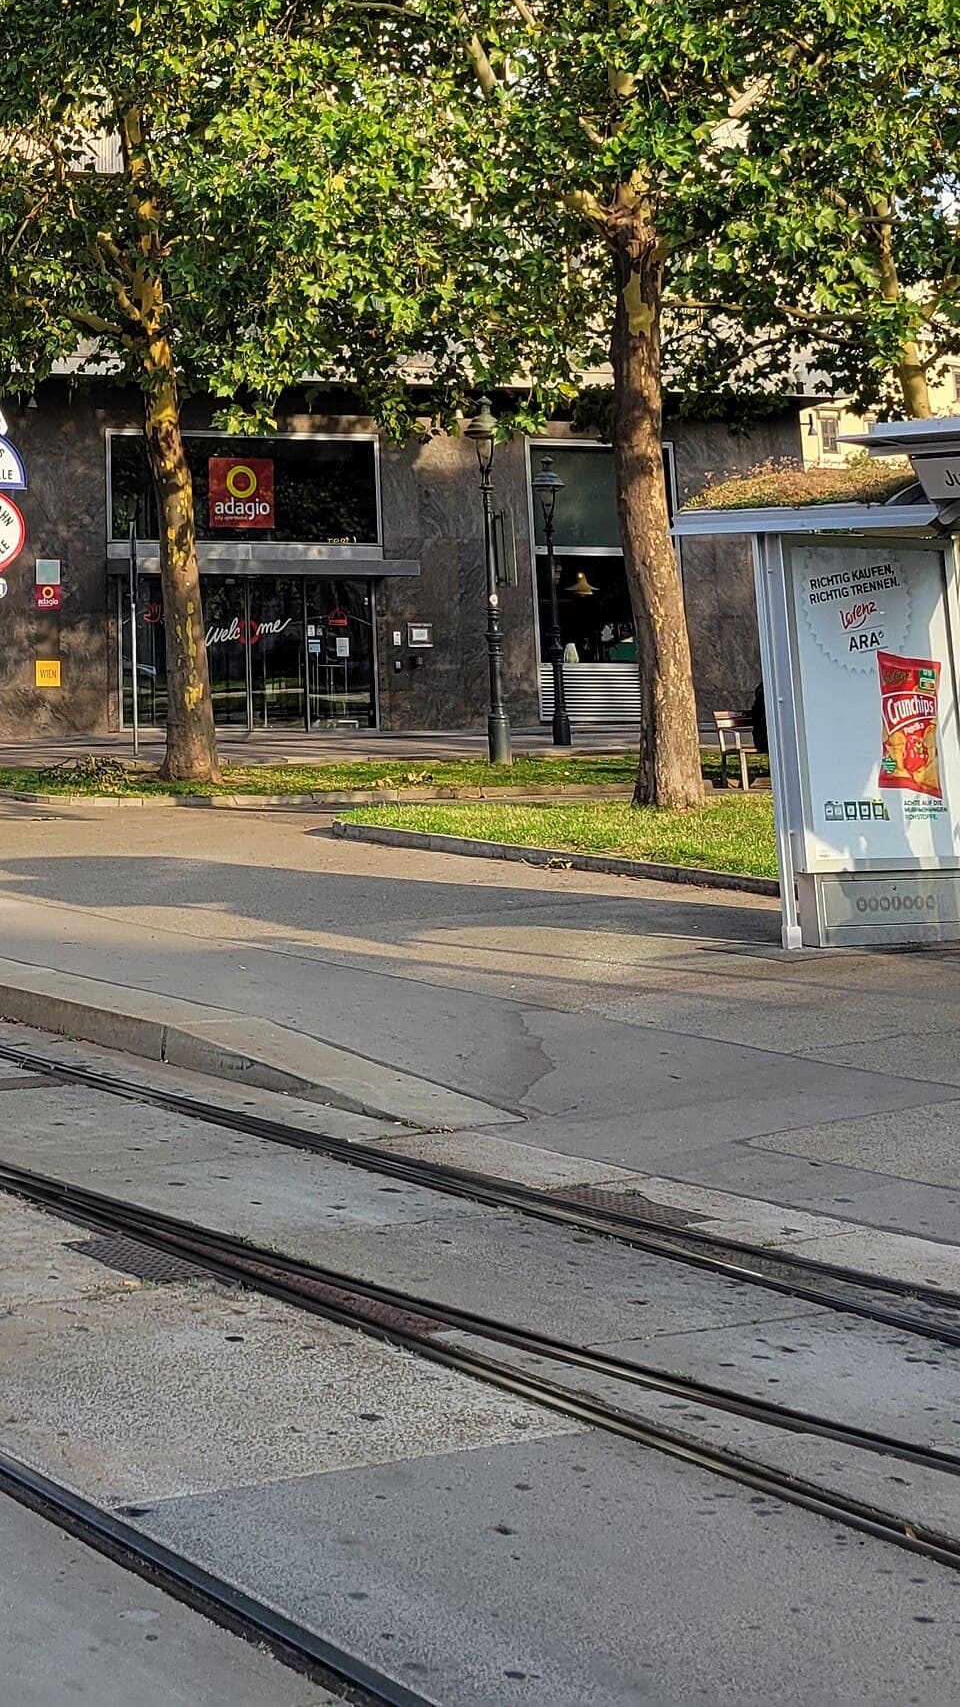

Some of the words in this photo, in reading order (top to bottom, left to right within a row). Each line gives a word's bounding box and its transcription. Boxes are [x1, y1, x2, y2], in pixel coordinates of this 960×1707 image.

[214, 497, 270, 520] adagio
[809, 572, 850, 590] RICHTIG
[851, 563, 895, 582] KAUFEN,
[37, 597, 59, 607] adagio
[809, 586, 849, 605] RICHTIG
[850, 576, 901, 596] TRENNEN.
[839, 601, 877, 629] Lorenz
[40, 669, 57, 679] WIEN
[887, 694, 934, 725] Crunchips
